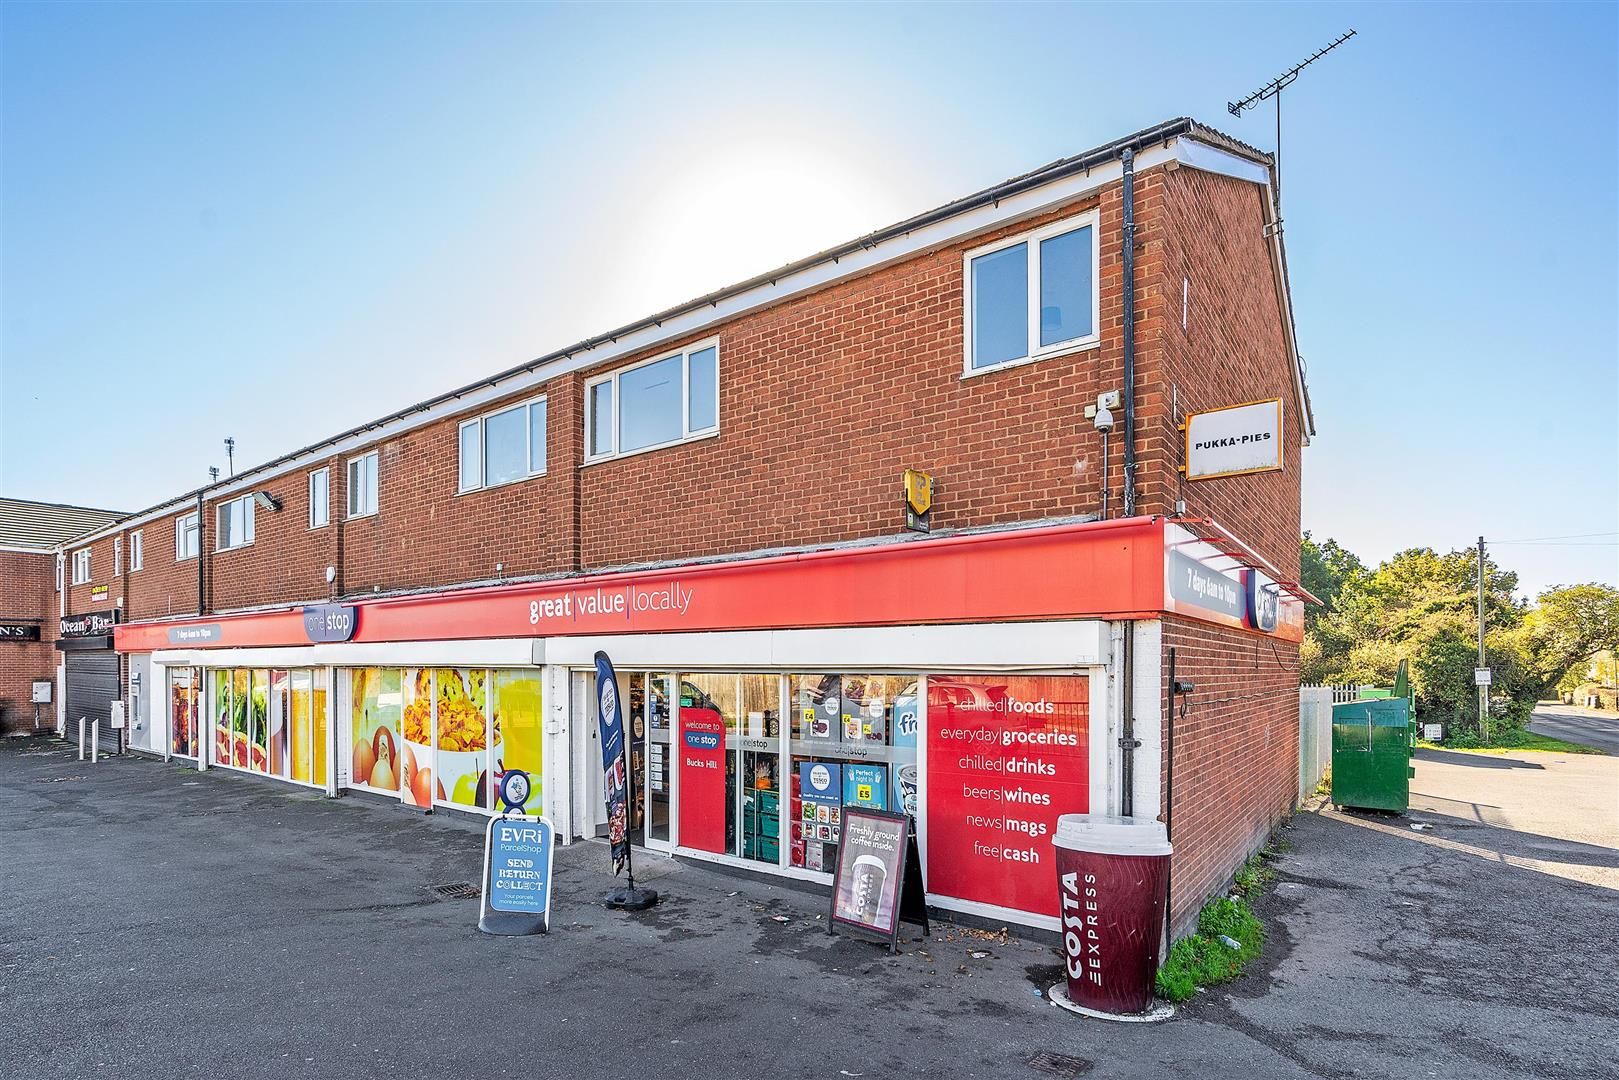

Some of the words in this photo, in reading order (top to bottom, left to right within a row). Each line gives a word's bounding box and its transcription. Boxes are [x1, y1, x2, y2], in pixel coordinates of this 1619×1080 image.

[1195, 432, 1271, 451] PUKKA-PIES
[1187, 567, 1192, 589] 7
[1193, 569, 1206, 599] days
[529, 592, 571, 625] great
[577, 587, 625, 615] value
[632, 581, 693, 616] locally
[60, 619, 84, 633] Ocean
[308, 615, 325, 632] one
[326, 612, 350, 635] stop
[960, 697, 1004, 712] chilled
[1007, 697, 1055, 714] foods
[685, 720, 712, 730] welcome
[712, 722, 720, 731] to
[687, 735, 700, 743] one
[700, 734, 717, 747] stop
[752, 739, 767, 750] stop
[940, 726, 999, 745] everyday
[1002, 728, 1078, 746] groceries
[686, 757, 704, 768] Bucks
[705, 759, 718, 769] Hill
[958, 754, 1002, 771] chilled
[1006, 757, 1056, 776] drinks
[859, 790, 870, 799] £5
[963, 783, 1001, 799] beers
[1004, 787, 1051, 806] wines
[849, 823, 874, 837] Freshly
[875, 831, 900, 842] ground
[966, 814, 1002, 829] news
[1006, 817, 1047, 837] mags
[500, 827, 543, 844] EVRi
[500, 843, 542, 855] ParcelShop
[850, 837, 872, 847] coffee
[872, 839, 895, 852] inside.
[974, 840, 1000, 857] free
[1003, 847, 1040, 863] cash
[507, 858, 534, 869] SEND
[498, 869, 541, 880] RETURN
[496, 880, 543, 891] COLLECT
[1062, 871, 1084, 980] COSTA
[1085, 873, 1102, 969] EXPRESS
